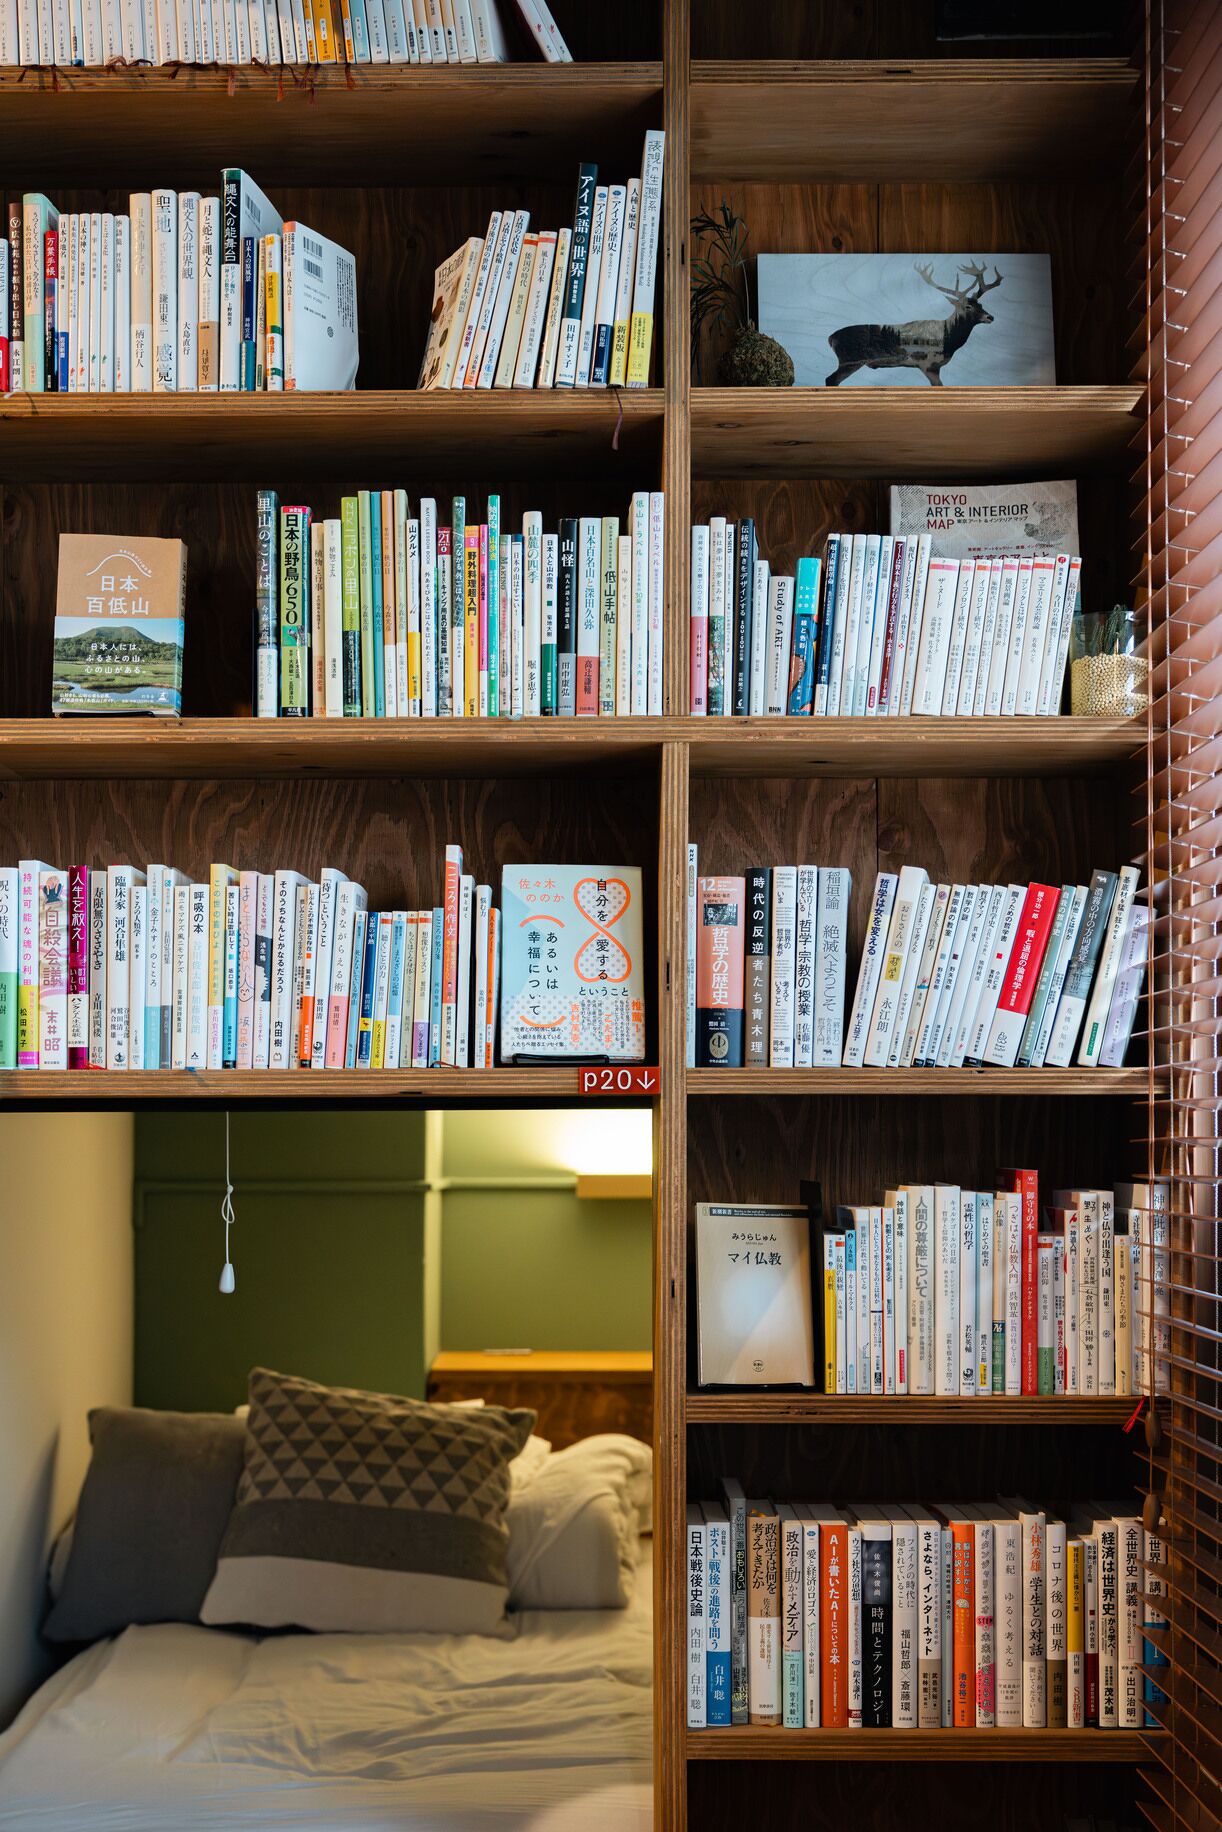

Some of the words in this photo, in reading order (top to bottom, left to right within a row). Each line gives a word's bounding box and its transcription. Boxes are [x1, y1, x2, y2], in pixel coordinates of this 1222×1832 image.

[570, 175, 594, 277] アイヌ語の世界
[926, 506, 950, 518] ART
[955, 507, 964, 517] &
[969, 504, 1028, 517] INTERIOR
[927, 495, 966, 505] TOKYO
[636, 500, 644, 556] 低山トラベル
[927, 520, 954, 529] MAP
[561, 540, 574, 567] 山怪
[86, 597, 149, 615] 百低山
[101, 575, 139, 592] 日本
[467, 551, 477, 616] 野外料理超入門
[603, 571, 616, 624] 低山手帖
[774, 582, 785, 613] Study
[775, 628, 784, 650] ART
[776, 615, 783, 625] of
[115, 876, 127, 910] 臨床家
[519, 879, 555, 890] 佐々木
[526, 894, 565, 902] ののか
[701, 879, 715, 891] 12
[193, 892, 204, 934] 呼吸の本
[115, 916, 127, 961] 河合隼雄
[277, 880, 288, 993] そのうちなんとかなるだろう
[528, 932, 540, 1016] 幸福について
[547, 932, 558, 990] あるいは
[712, 928, 728, 1005] 哲学の歴史
[823, 925, 839, 1012] 絶滅へようこそ
[579, 987, 629, 997] ということ
[19, 1009, 27, 1047] 松田青子
[274, 1022, 283, 1047] 内田樹
[877, 999, 892, 1032] 永江朗
[584, 1070, 632, 1092] p20
[728, 1252, 781, 1265] マイ仏教
[732, 1233, 776, 1241] みうらじゅん
[916, 1196, 928, 1298] 人間の尊厳について
[1009, 1205, 1019, 1284] つぎはぎ仏教入門
[1102, 1201, 1111, 1278] 神と仏の出逢う国
[752, 1524, 764, 1590] 考えてきたか
[765, 1524, 777, 1594] 政治学は何を
[1006, 1539, 1016, 1575] 東浩紀
[1030, 1523, 1042, 1572] 小林秀雄
[1126, 1528, 1138, 1576] 全世界史
[691, 1531, 703, 1617] 日本戦後史論
[785, 1531, 800, 1642] 政治を動かすメディア
[923, 1531, 933, 1656] さよなら、インターネット
[1102, 1531, 1115, 1615] 経済は世界史
[1126, 1583, 1138, 1606] 講義
[1029, 1577, 1043, 1656] 学生との対話
[1050, 1545, 1063, 1651] コロナ後の世界
[1005, 1593, 1014, 1668] ゆるく考える
[871, 1607, 884, 1725] 時間とテクノロジー
[1127, 1677, 1136, 1717] 出口治明
